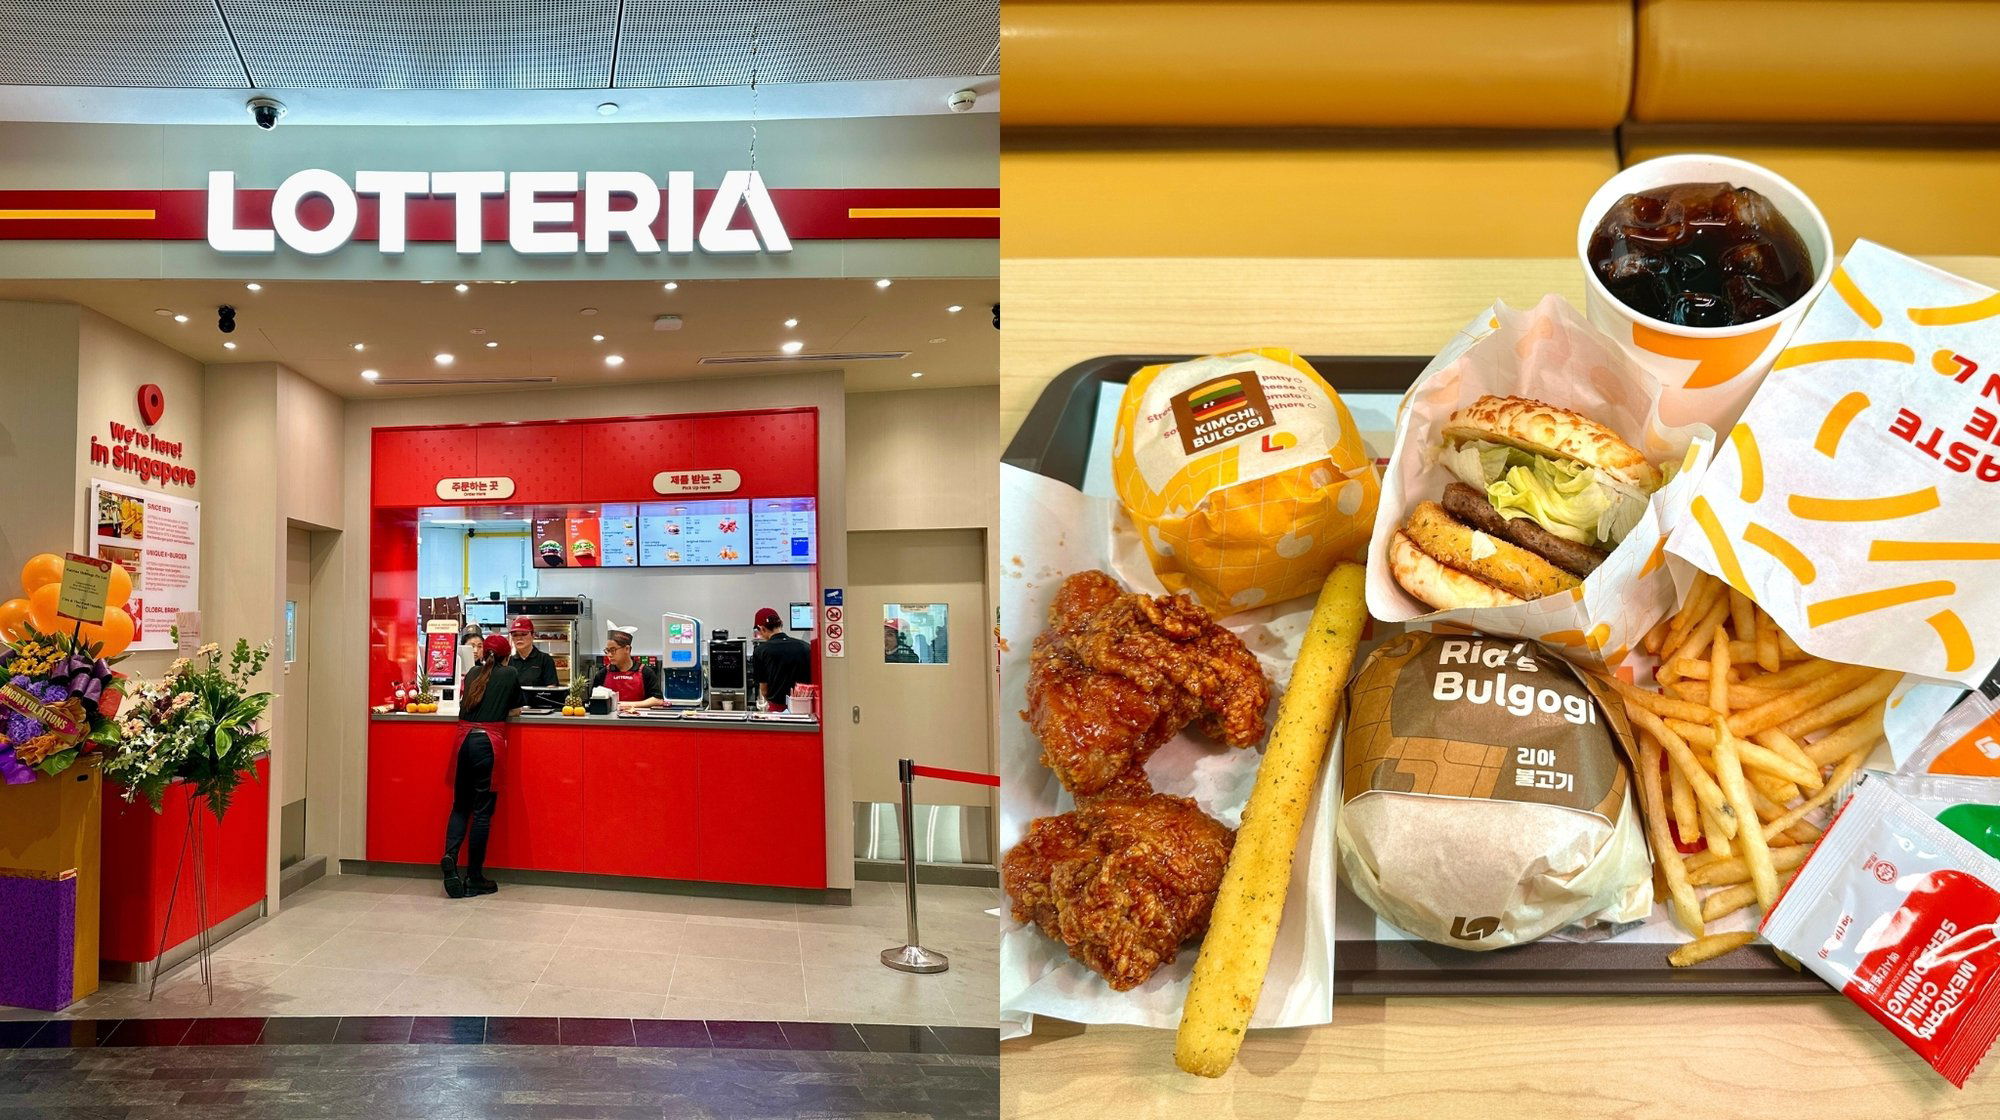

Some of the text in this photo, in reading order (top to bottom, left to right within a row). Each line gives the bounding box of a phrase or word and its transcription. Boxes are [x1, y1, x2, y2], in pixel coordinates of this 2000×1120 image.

[207, 168, 794, 255] LOTTERIA
[1262, 375, 1292, 383] patty
[1192, 416, 1265, 449] BULGOGI
[1194, 407, 1256, 436] KIMCHI
[109, 421, 182, 458] We're here!
[1888, 407, 2000, 482] ASTE
[90, 435, 196, 485] in Singapore
[452, 480, 498, 492] 주문하는 곳
[691, 474, 710, 485] 받는
[712, 473, 722, 484] 곳
[147, 503, 161, 511] SINCE
[1438, 640, 1539, 673] Ria's
[1433, 671, 1597, 725] Bulgogi
[1516, 747, 1556, 767] 리아
[1514, 768, 1574, 792] 불고기
[1900, 980, 1940, 1028] CHILI
[1918, 960, 1977, 1040] MEXICAN
